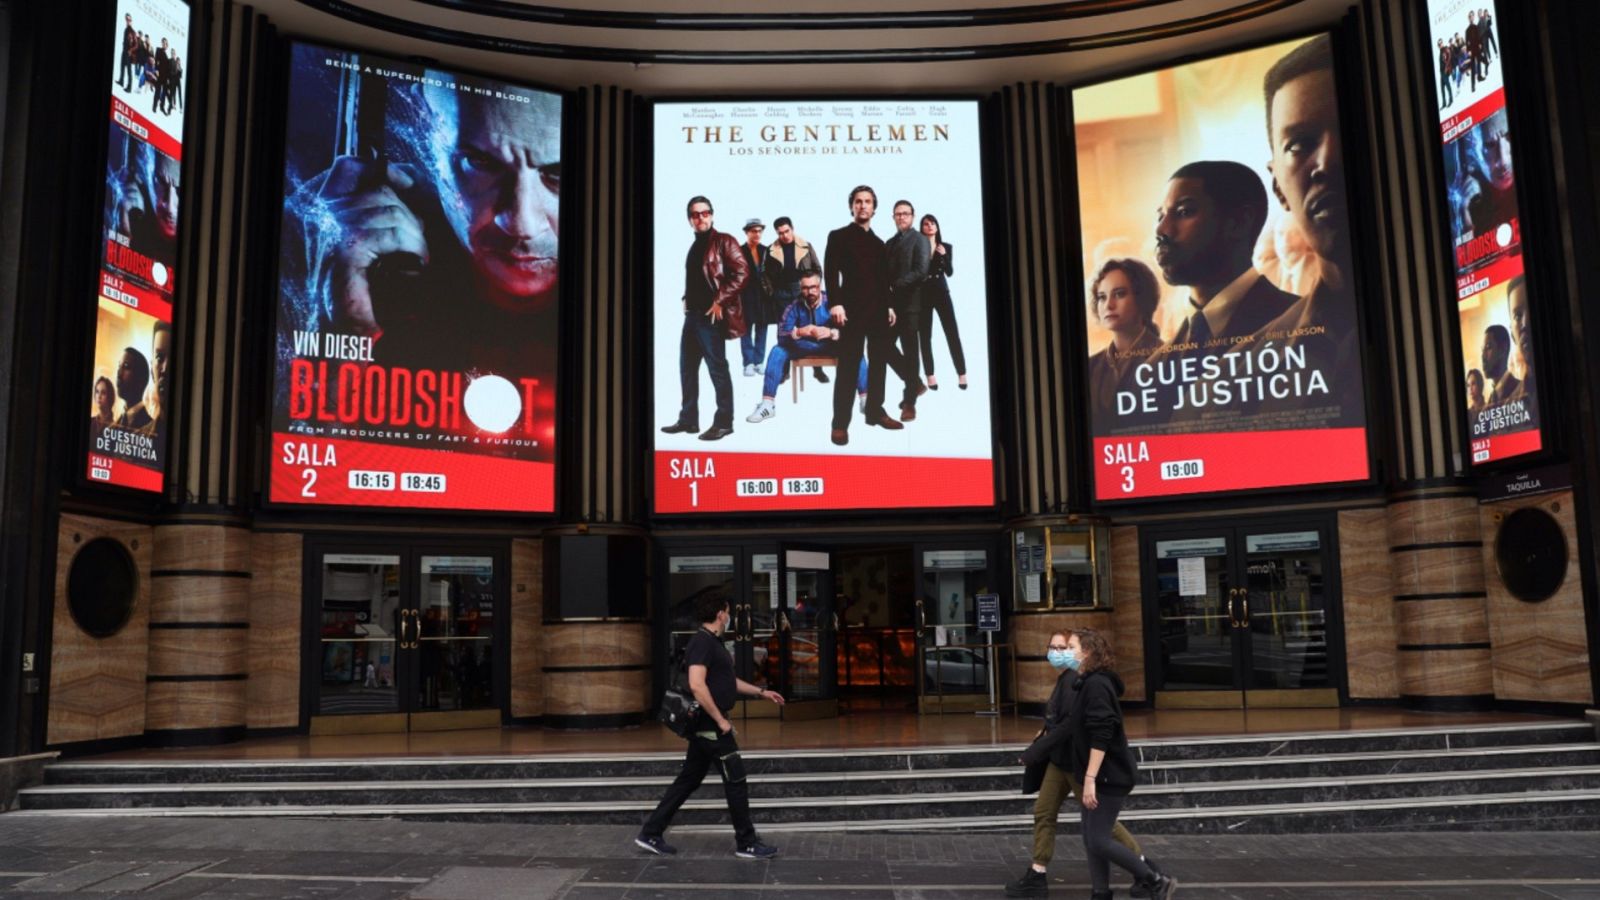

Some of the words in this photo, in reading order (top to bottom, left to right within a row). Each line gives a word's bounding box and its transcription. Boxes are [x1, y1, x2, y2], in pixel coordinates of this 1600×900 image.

[325, 58, 361, 71] BEING
[376, 69, 442, 87] SUPERHERO
[446, 82, 456, 90] IS
[474, 88, 492, 96] HIS
[495, 91, 530, 103] BLOOD
[682, 125, 744, 143] THE
[760, 124, 949, 142] GENTLEMEN
[729, 147, 754, 156] LOS
[758, 145, 817, 155] SEÑORES
[822, 146, 838, 154] DE
[843, 146, 859, 154] LA
[863, 146, 903, 154] MAFIA
[294, 330, 320, 357] VIN
[325, 333, 374, 362] DIESEL
[1203, 338, 1228, 349] JAMIE
[1230, 334, 1256, 345] FOXX
[1287, 326, 1325, 337] LARSON
[1135, 341, 1306, 388] CUESTIÓN
[1117, 388, 1158, 416] DE
[1173, 369, 1329, 411] JUSTICIA
[1478, 400, 1525, 422] CUESTIÓN
[1474, 423, 1486, 435] DE
[1489, 411, 1530, 432] JUSTICIA
[103, 427, 153, 449] CUESTIÓN
[289, 425, 325, 434] FROM
[332, 428, 410, 440] PRODUCERS
[416, 433, 432, 441] OF
[438, 434, 468, 443] FAST
[486, 437, 538, 447] FURIOUS
[96, 437, 111, 451] DE
[114, 442, 157, 461] JUSTICIA
[283, 442, 337, 467] SALA
[1103, 441, 1150, 465] SALA
[670, 458, 716, 479] SALA
[1121, 466, 1135, 492] 3
[1166, 462, 1199, 477] 19:00
[301, 468, 318, 497] 2
[354, 473, 390, 488] 16:15
[406, 476, 441, 490] 18:45
[742, 481, 773, 494] 16:00
[788, 480, 819, 493] 18:30
[1506, 479, 1542, 493] TAQUILLA
[689, 481, 698, 507] 1
